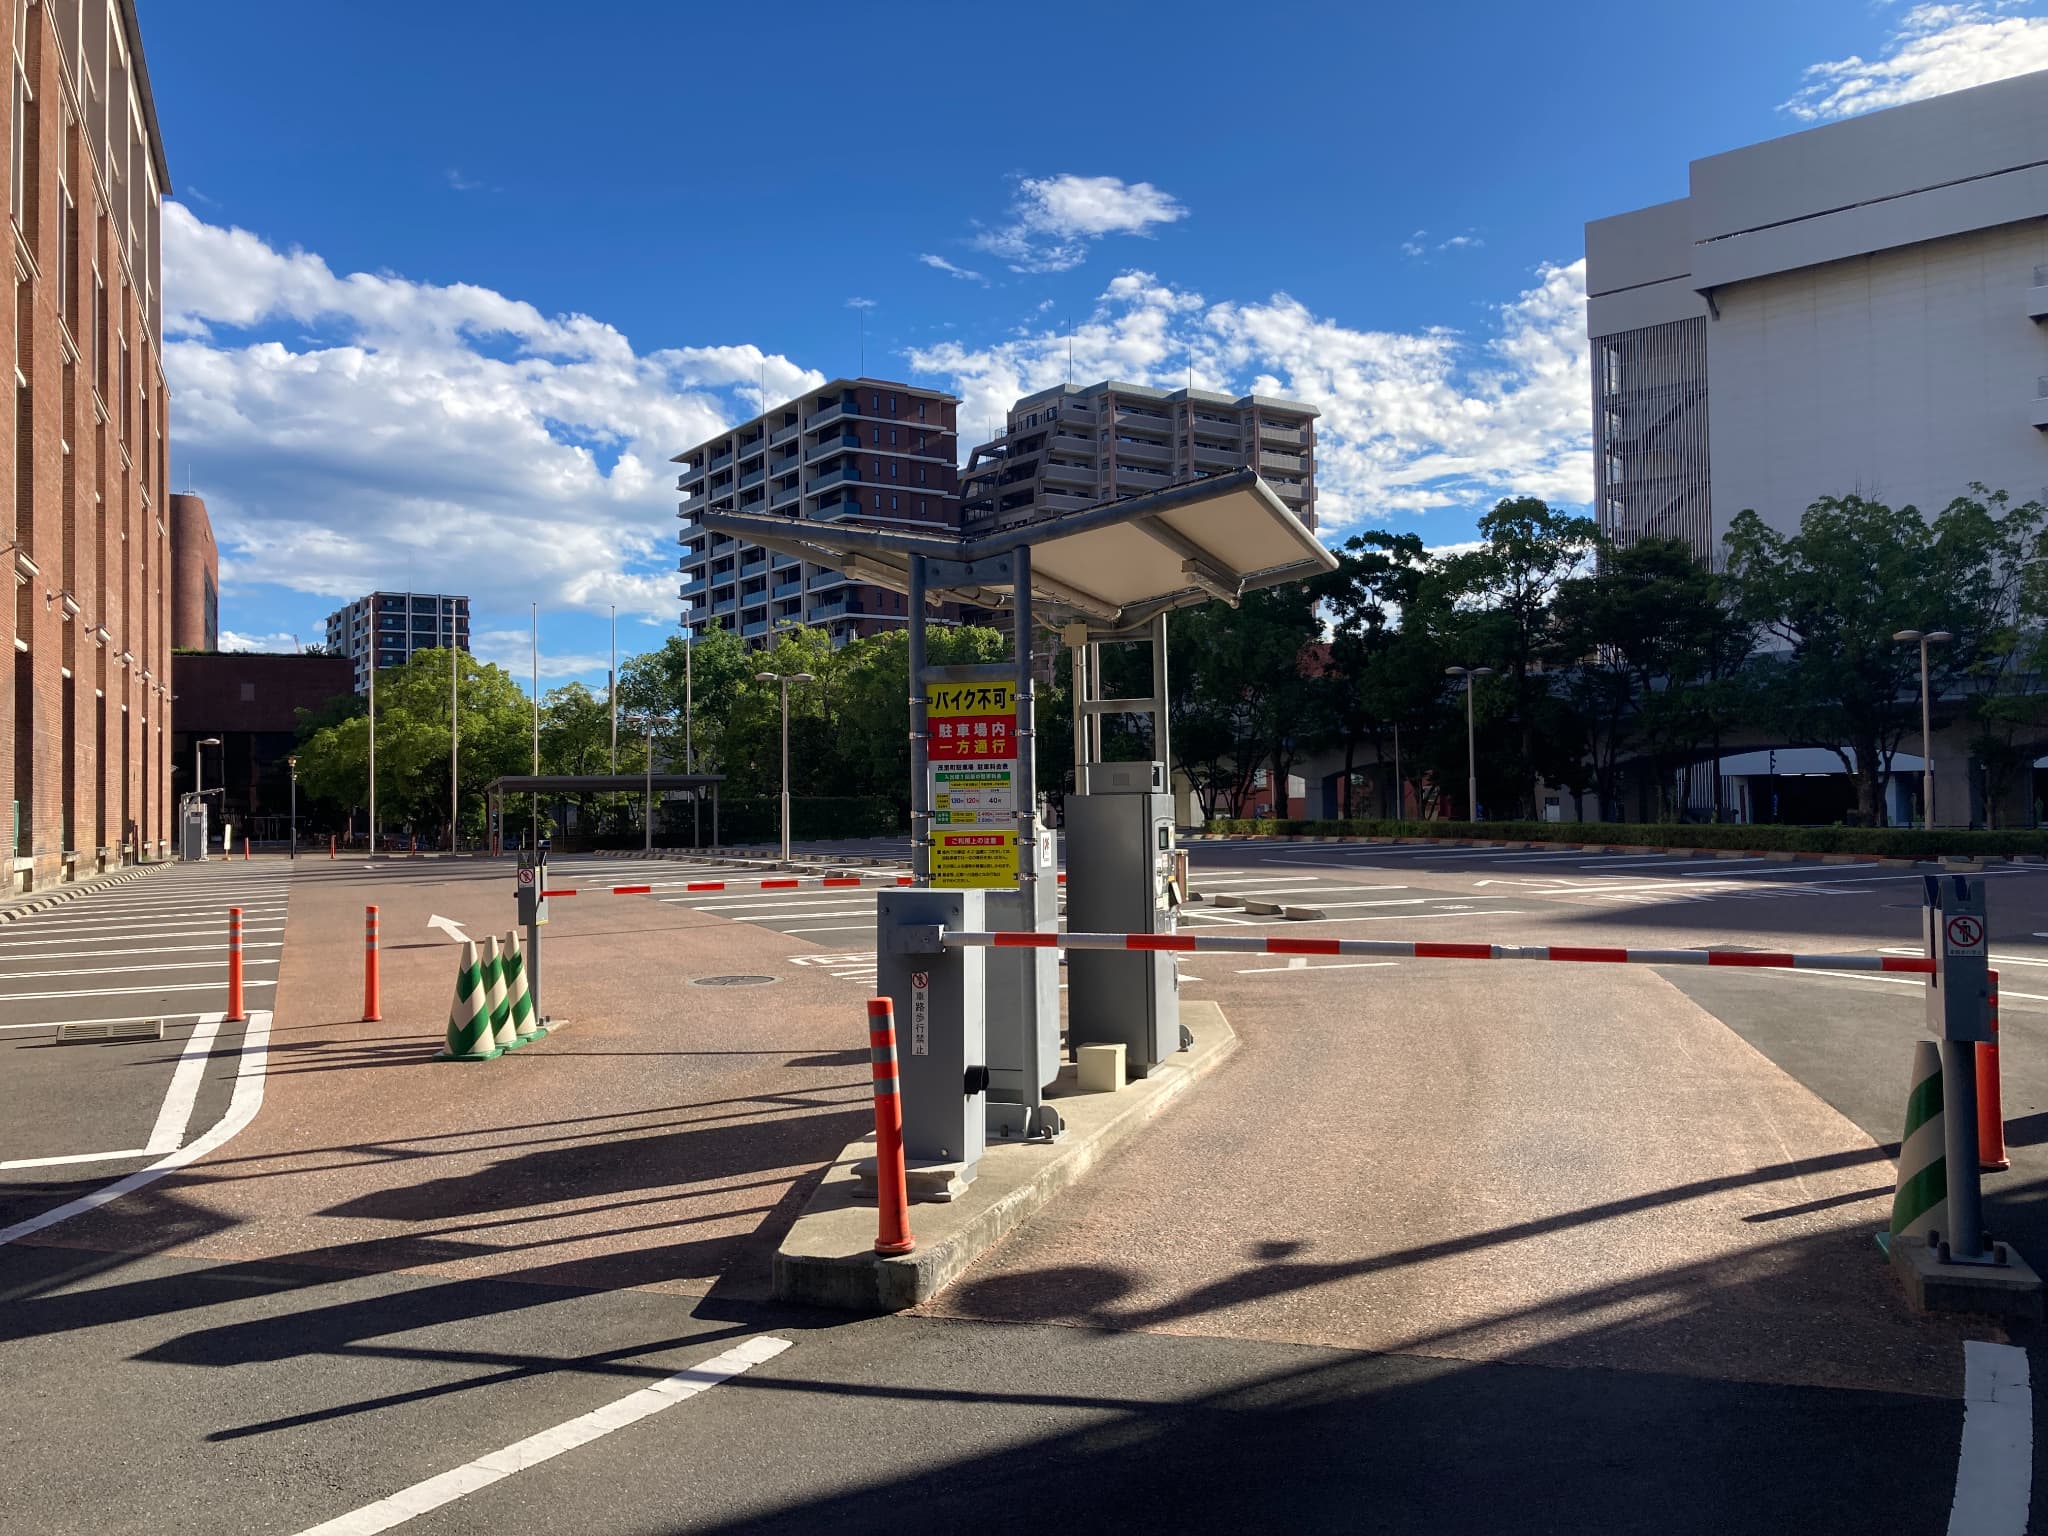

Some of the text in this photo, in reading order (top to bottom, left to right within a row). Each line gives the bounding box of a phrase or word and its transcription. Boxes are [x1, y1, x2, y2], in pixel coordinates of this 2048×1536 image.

[935, 688, 1007, 710] バイク不可
[938, 722, 1006, 738] 駐車場内
[939, 739, 1006, 754] 一方通行
[915, 992, 925, 1055] 車路歩行禁止
